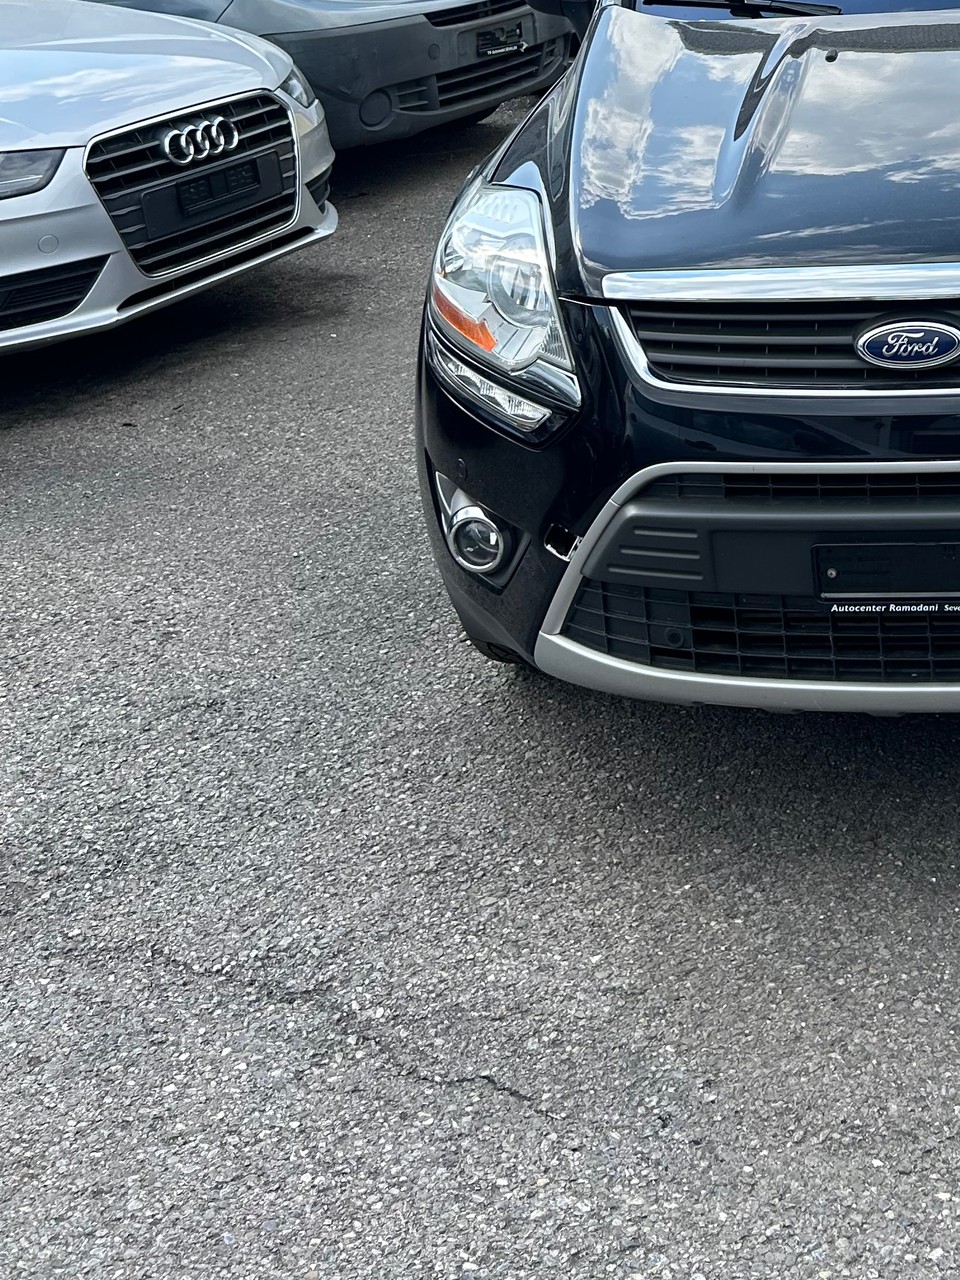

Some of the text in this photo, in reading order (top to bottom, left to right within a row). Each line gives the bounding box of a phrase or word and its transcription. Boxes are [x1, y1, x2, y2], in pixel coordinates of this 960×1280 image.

[882, 331, 939, 357] Ford
[830, 603, 887, 613] Autocenter
[889, 603, 939, 612] Ramadani
